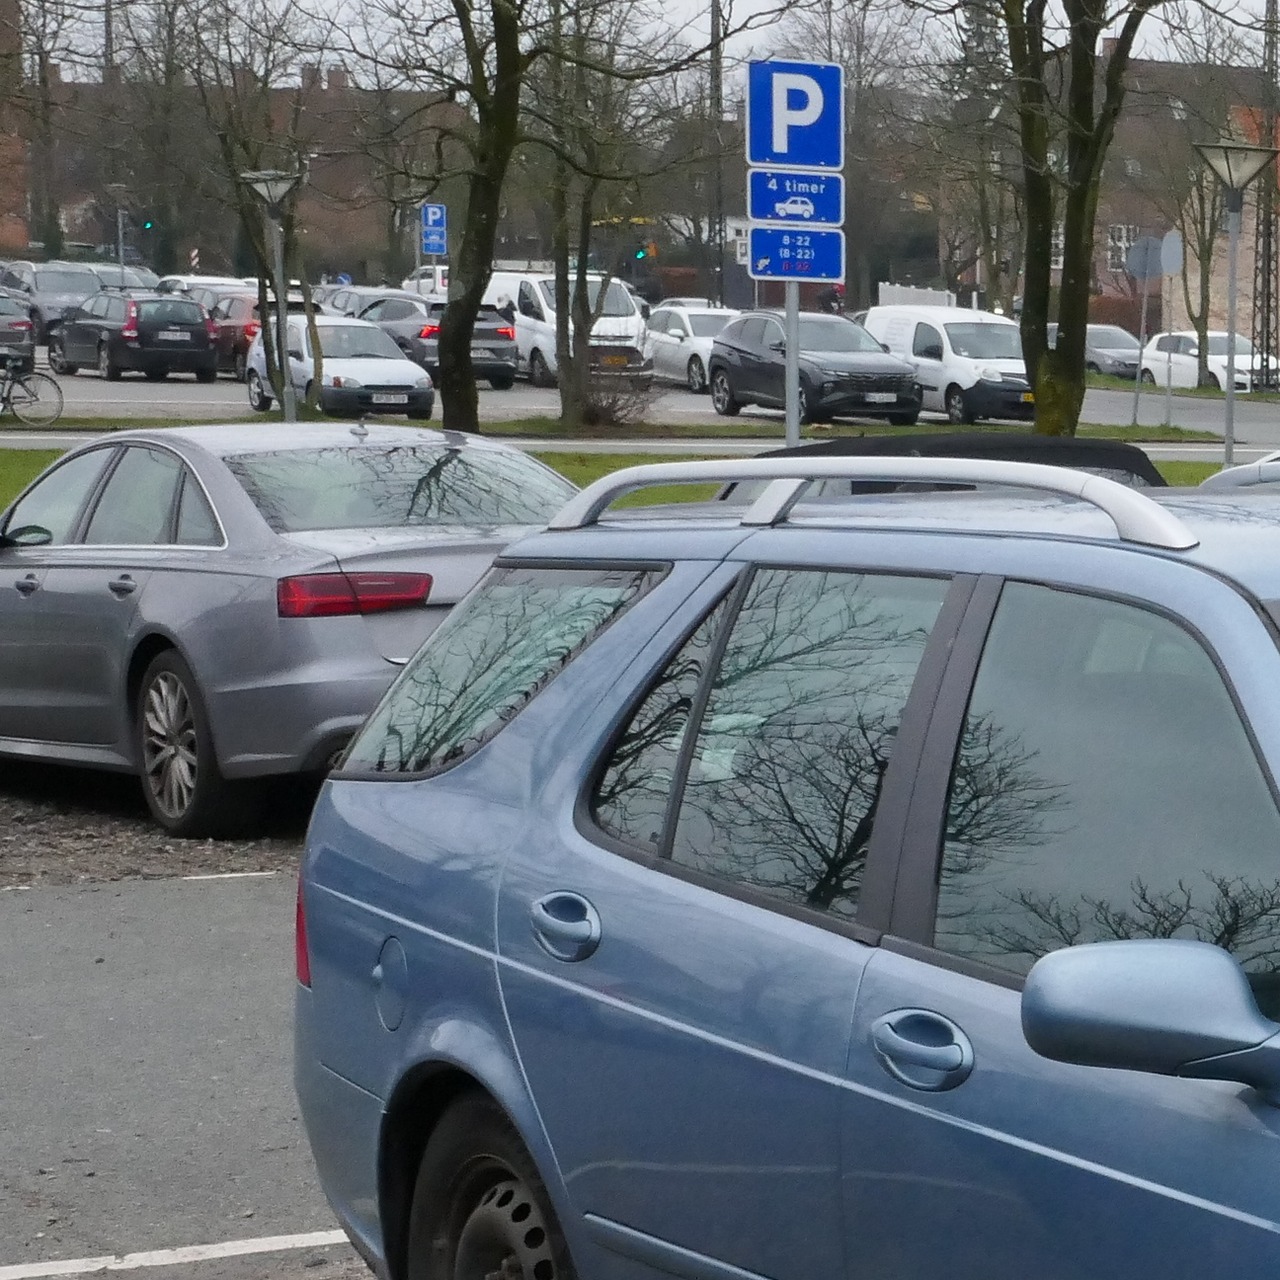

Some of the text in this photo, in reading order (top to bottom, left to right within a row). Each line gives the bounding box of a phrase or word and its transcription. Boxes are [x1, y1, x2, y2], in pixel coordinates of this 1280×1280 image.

[771, 73, 824, 154] P
[767, 178, 826, 194] 4 timer
[427, 207, 441, 226] P
